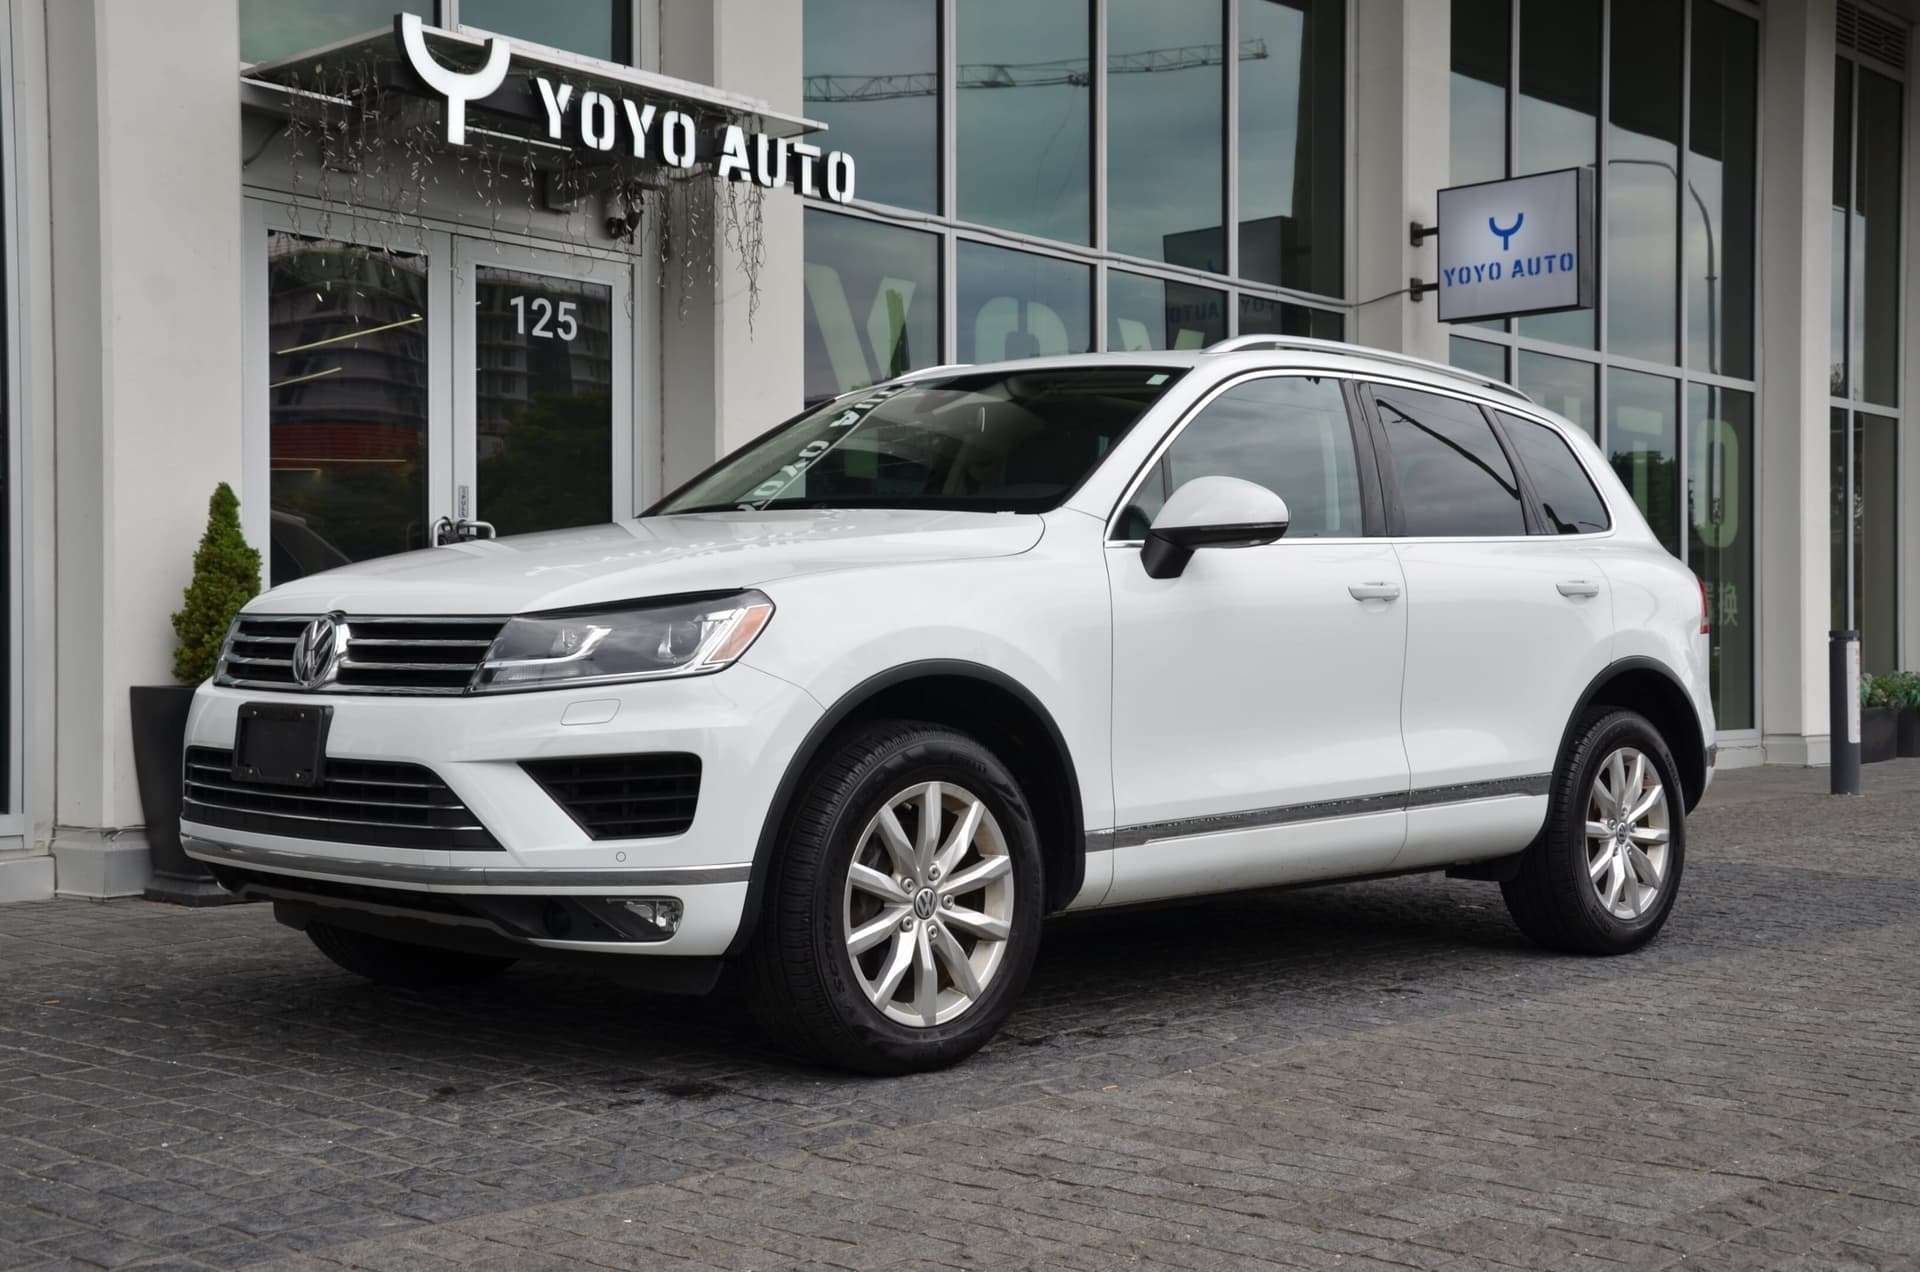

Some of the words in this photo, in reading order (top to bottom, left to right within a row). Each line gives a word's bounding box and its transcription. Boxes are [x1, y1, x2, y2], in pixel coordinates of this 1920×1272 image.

[533, 76, 696, 169] YOYO
[719, 125, 855, 202] AUTO
[1444, 262, 1501, 287] YOYO
[1512, 252, 1574, 278] AUTO
[510, 295, 578, 341] 125
